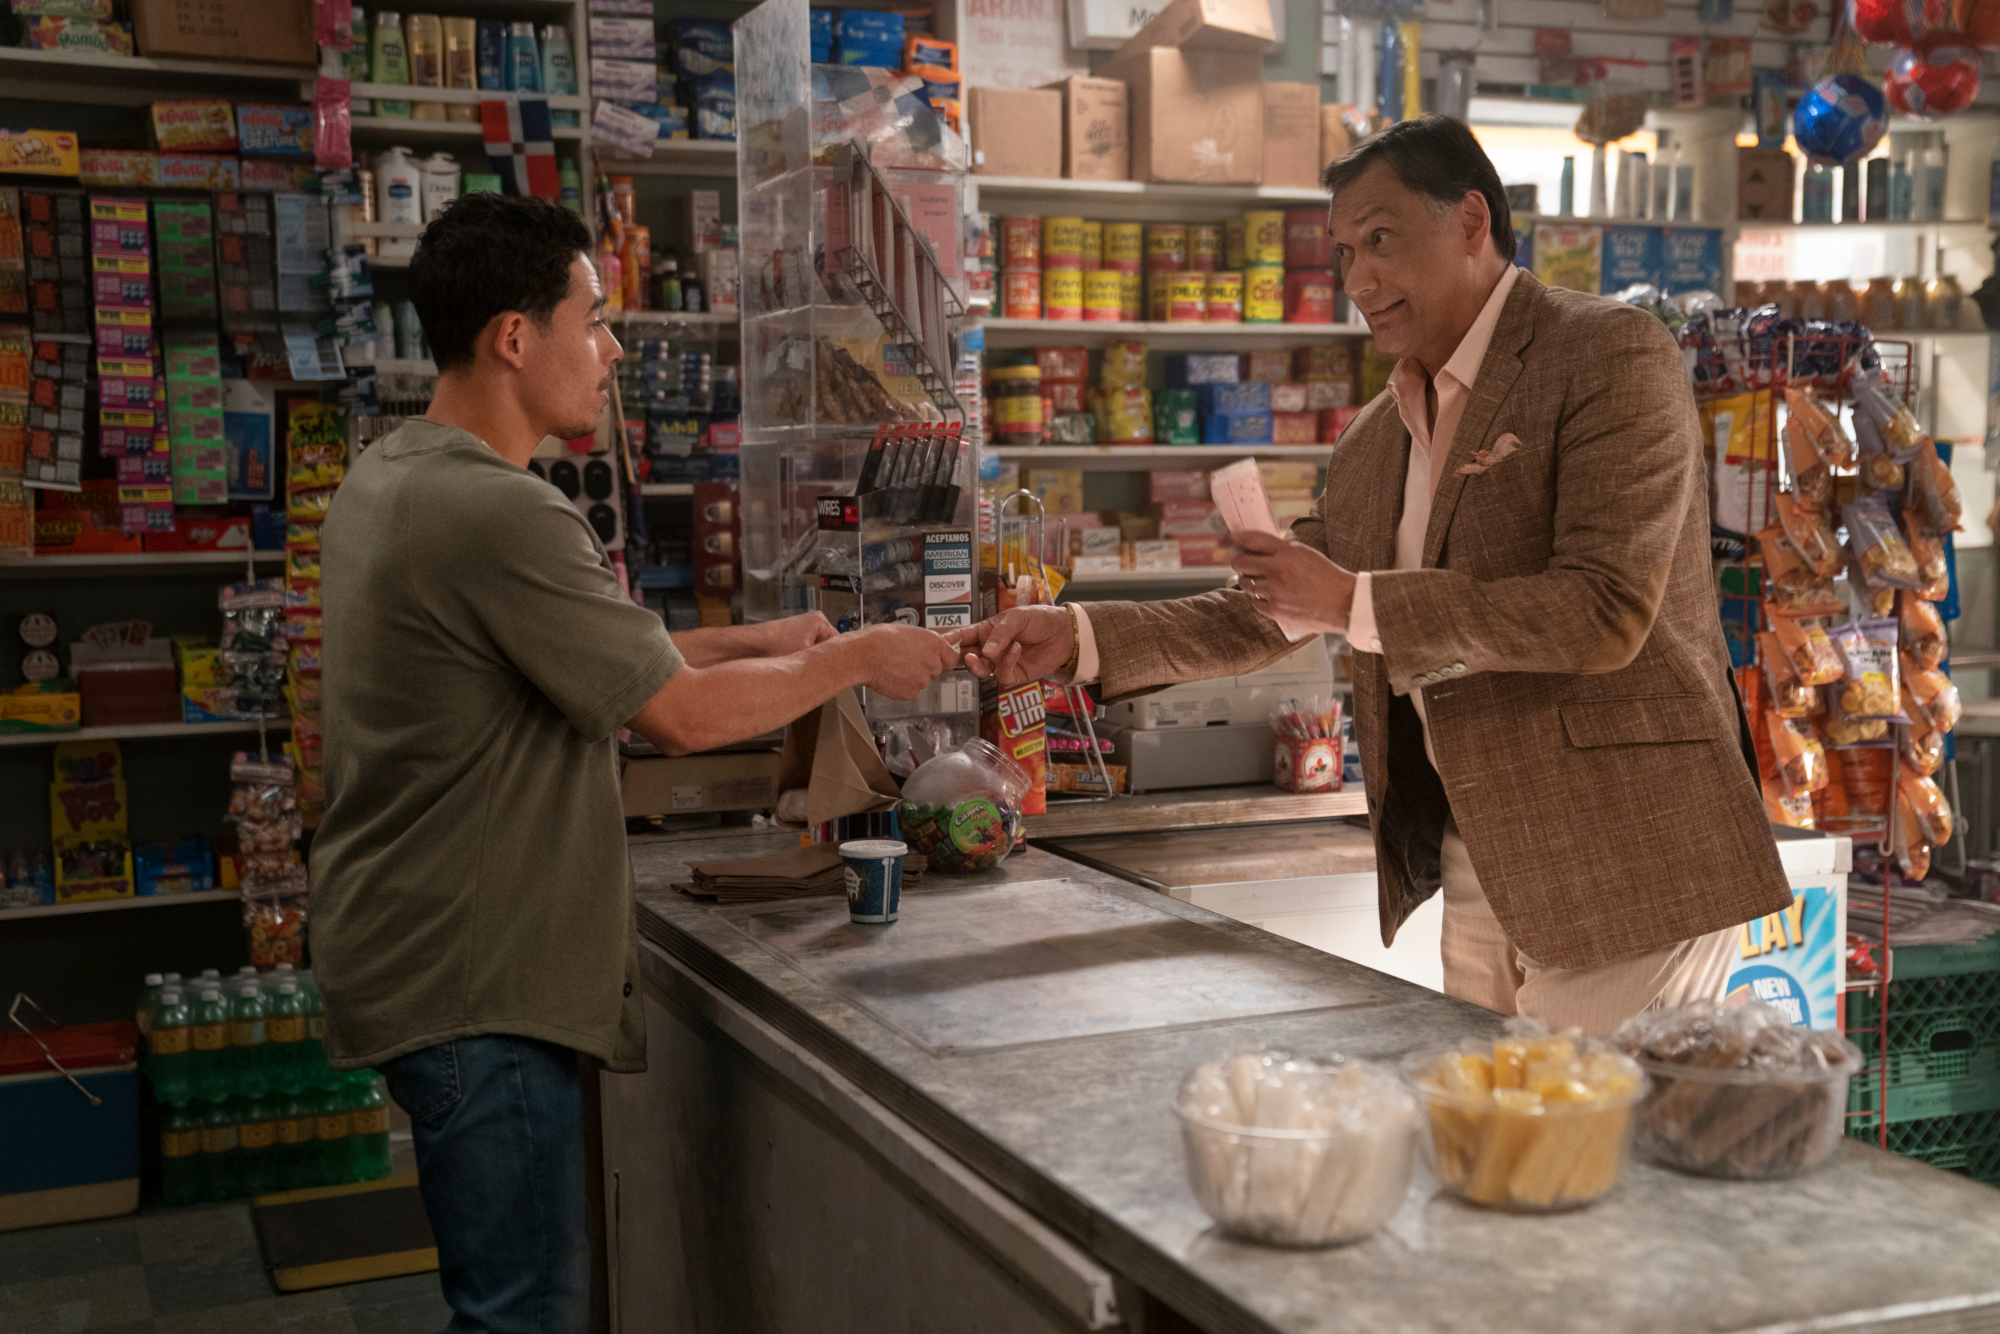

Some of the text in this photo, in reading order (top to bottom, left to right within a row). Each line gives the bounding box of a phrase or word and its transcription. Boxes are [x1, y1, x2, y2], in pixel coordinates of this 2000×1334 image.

[57, 32, 110, 49] Mamba
[658, 419, 699, 435] Advil
[818, 499, 840, 516] WIRES
[926, 533, 970, 544] ACEPTAMOS
[925, 550, 968, 559] AMERICAN
[934, 559, 971, 568] EXPRESS
[929, 581, 966, 589] DISCOVER
[934, 615, 962, 627] VISA
[1739, 895, 1805, 959] LAY
[1752, 976, 1791, 1000] NEW
[1765, 997, 1803, 1025] ORK
